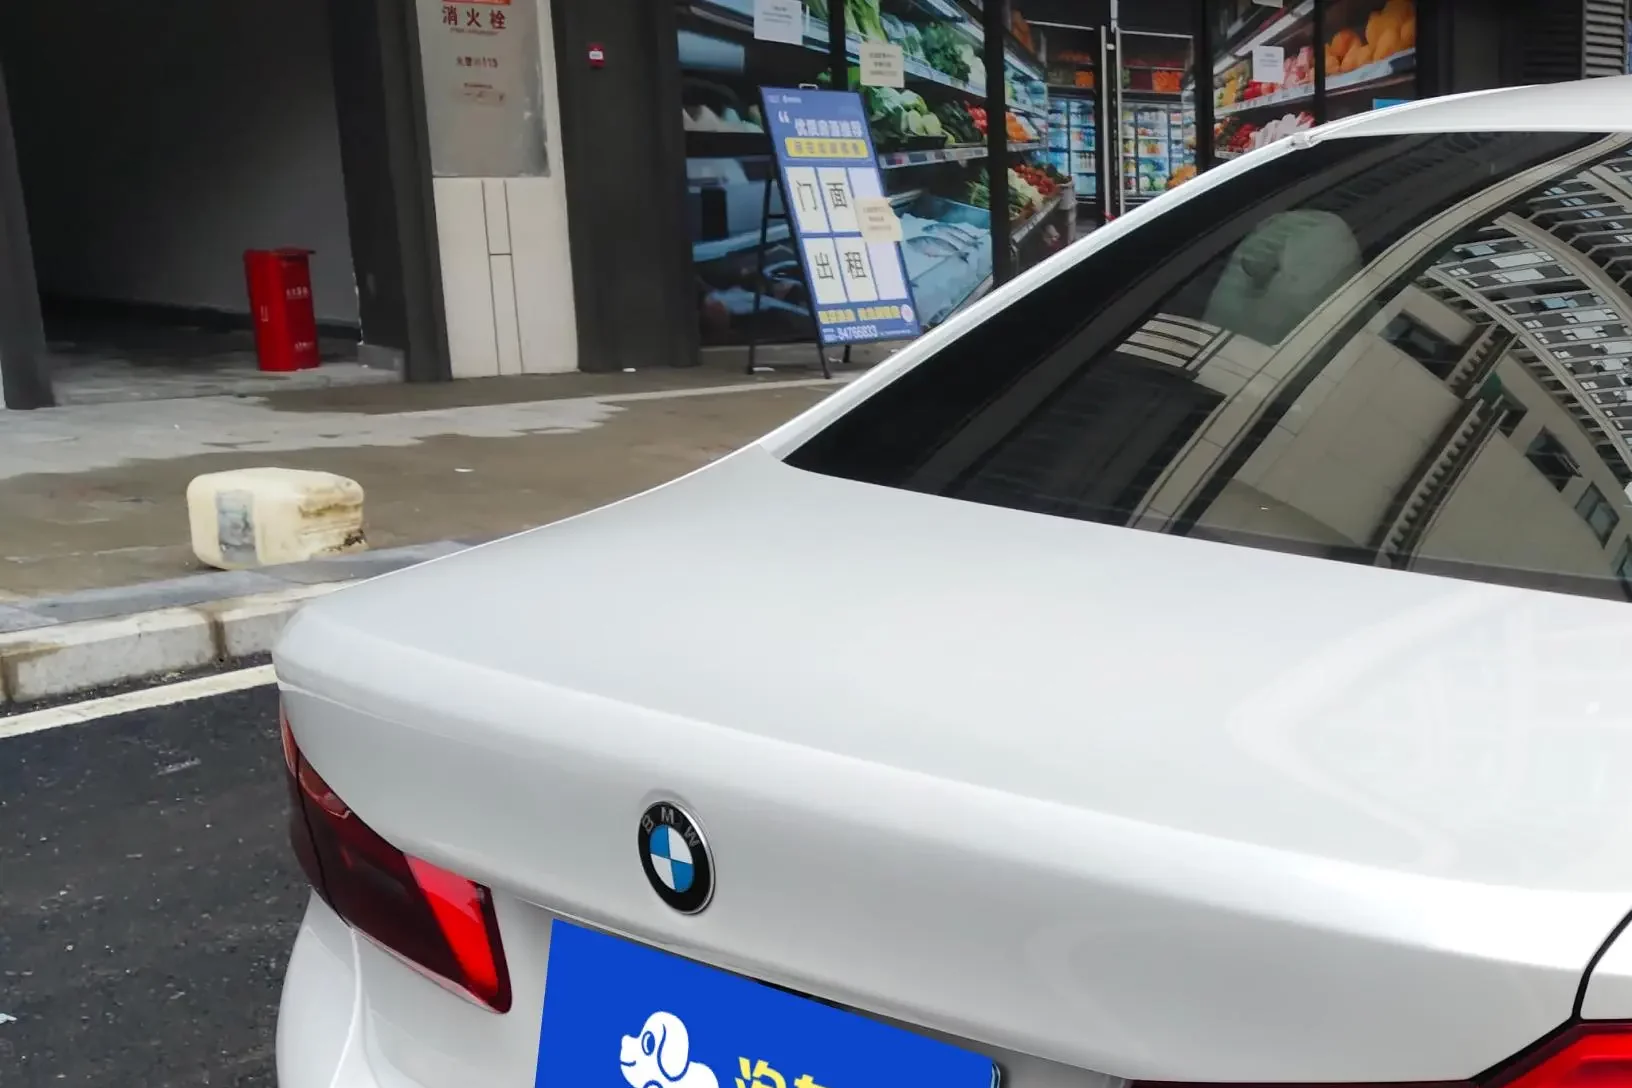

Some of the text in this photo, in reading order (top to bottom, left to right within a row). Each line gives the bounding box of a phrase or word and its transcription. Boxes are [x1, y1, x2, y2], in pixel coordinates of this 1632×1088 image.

[442, 6, 506, 29] 消火栓
[796, 180, 848, 212] 门面
[814, 251, 868, 281] 出租
[641, 806, 701, 847] BMW
